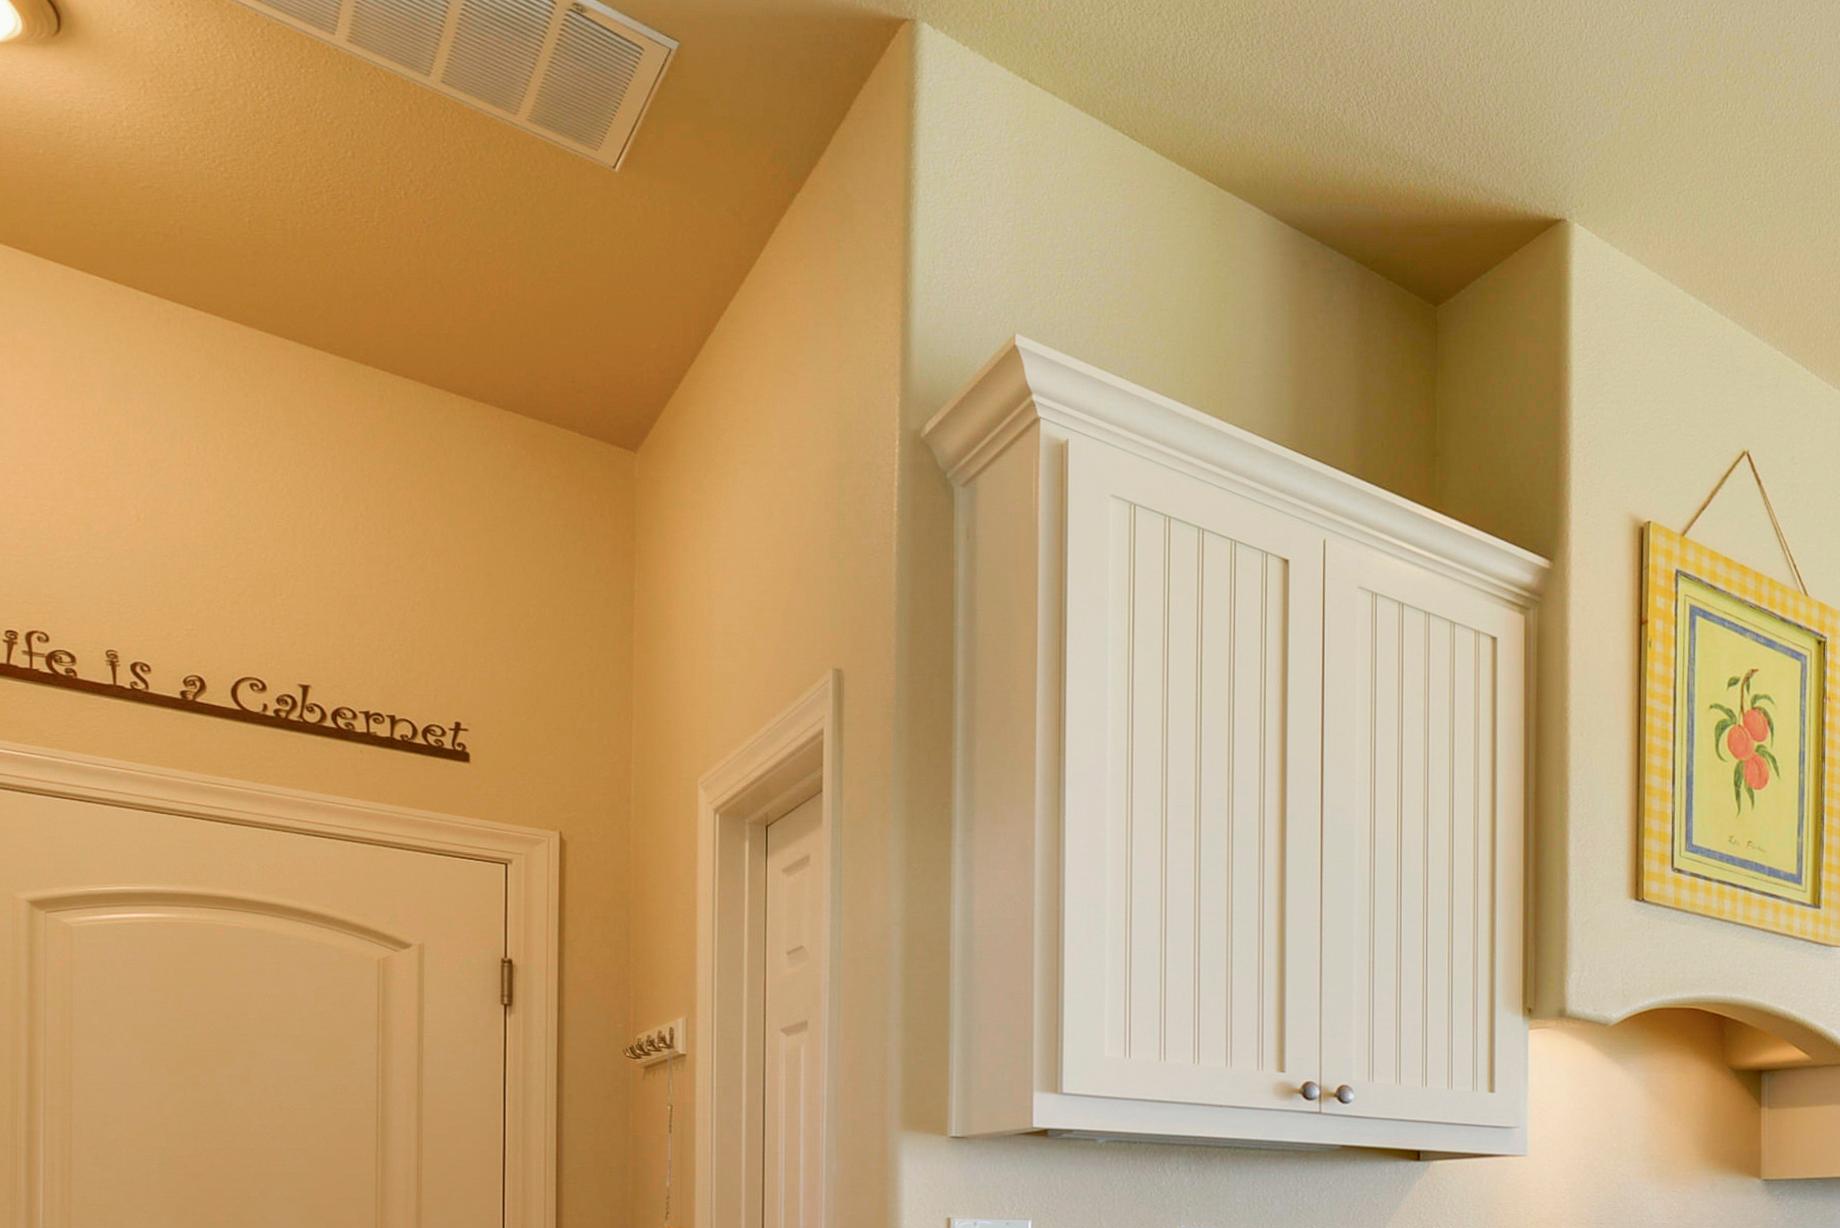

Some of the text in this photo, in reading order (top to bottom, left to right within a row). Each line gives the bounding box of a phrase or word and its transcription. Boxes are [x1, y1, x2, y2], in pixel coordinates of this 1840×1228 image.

[2, 629, 470, 752] ife is a Cabernet
